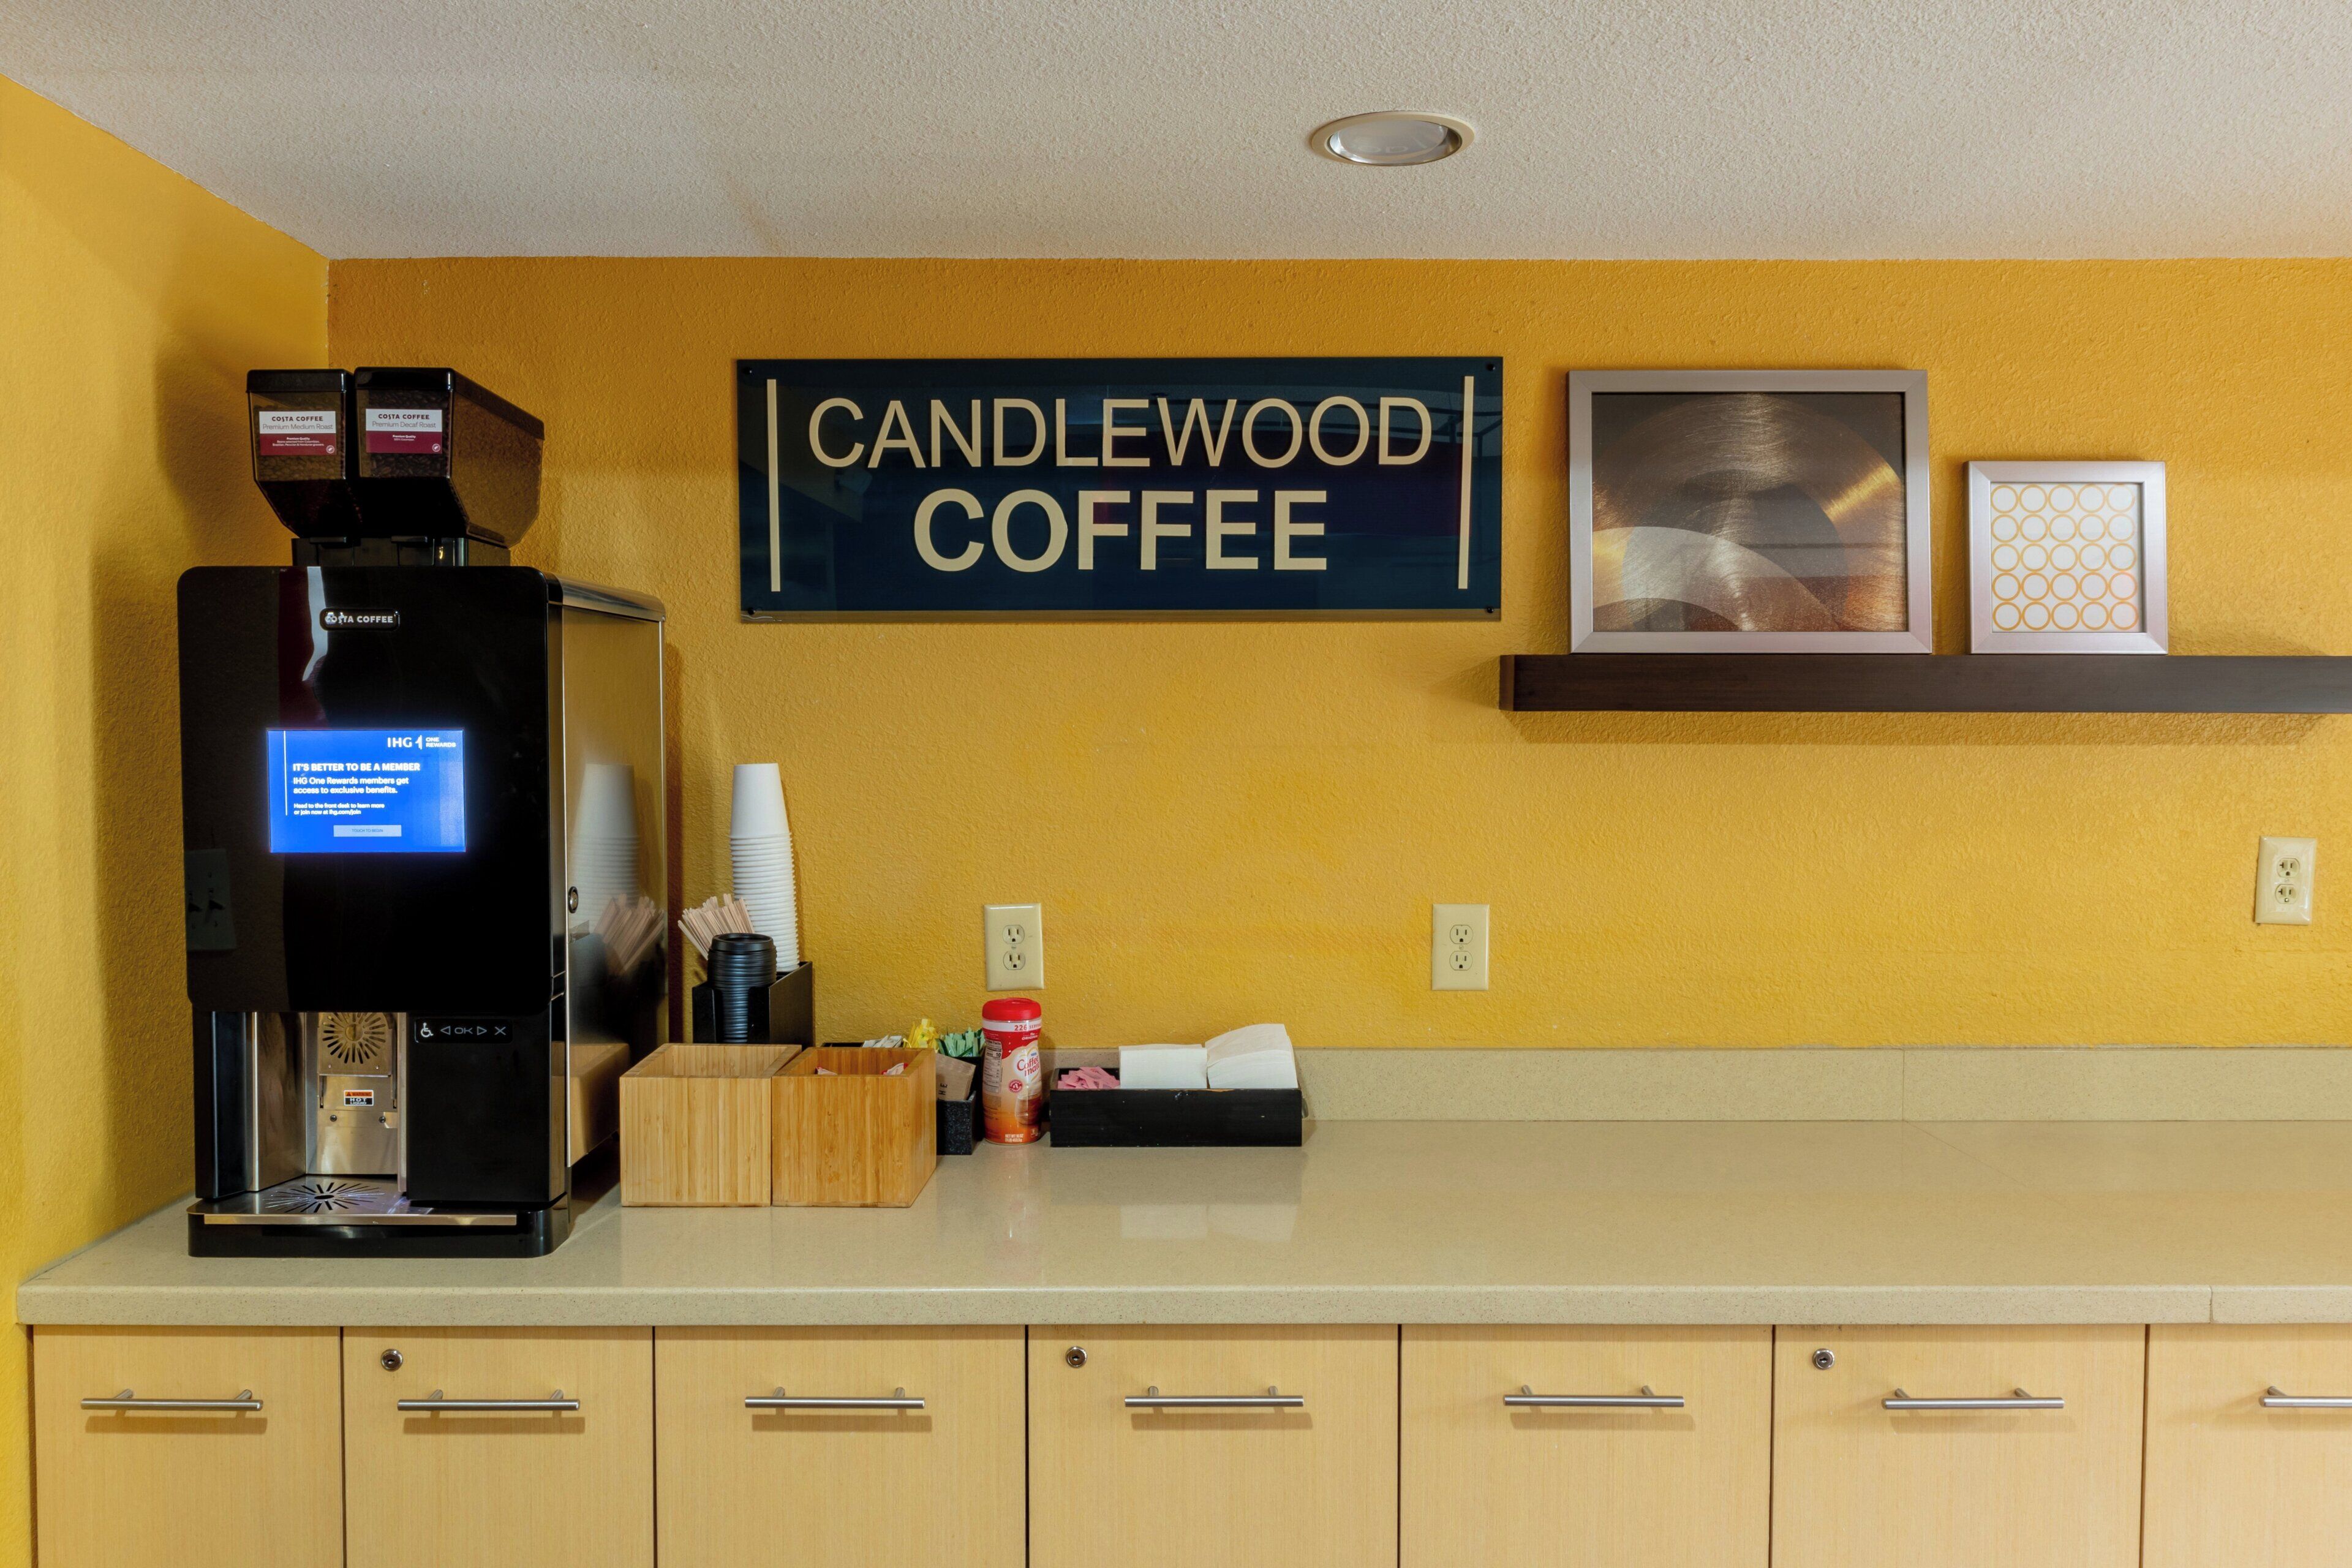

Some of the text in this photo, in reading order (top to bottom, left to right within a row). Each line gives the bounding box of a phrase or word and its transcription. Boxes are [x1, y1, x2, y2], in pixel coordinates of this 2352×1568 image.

[808, 396, 1433, 469] CANDLEWOOD
[913, 488, 1327, 573] COFFEE
[387, 737, 412, 748] IHG
[293, 763, 420, 771] IT'S BETTER TO BE A MEMBER
[396, 777, 409, 786] get
